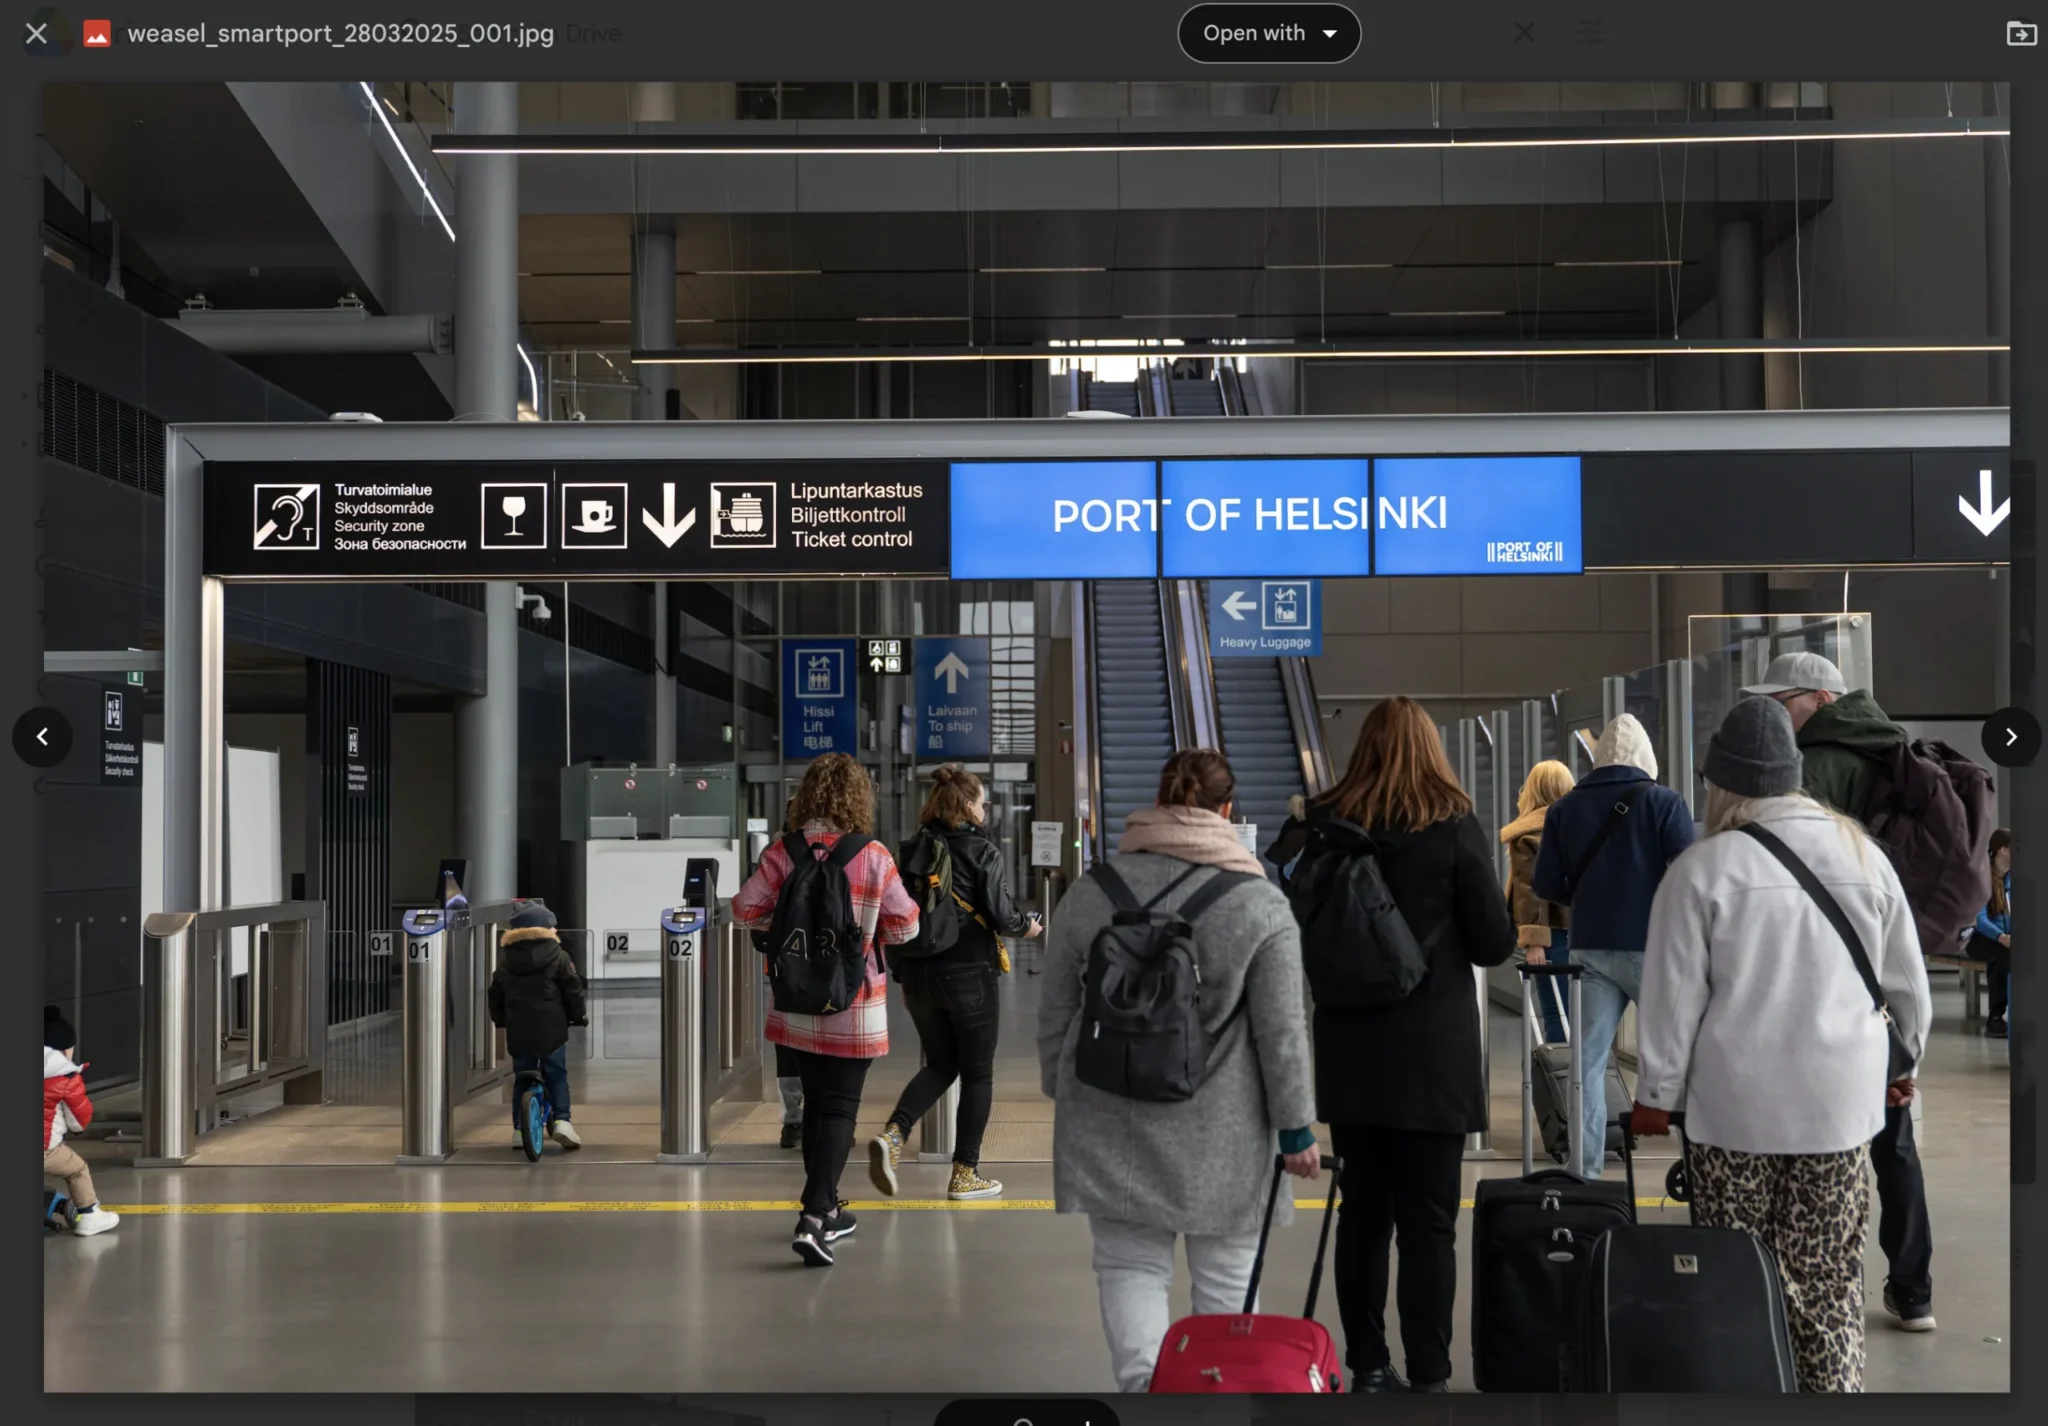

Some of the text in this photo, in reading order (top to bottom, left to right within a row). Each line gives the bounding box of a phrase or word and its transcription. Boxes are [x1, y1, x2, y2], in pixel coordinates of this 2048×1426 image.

[335, 484, 433, 496] Turvatoimialue
[792, 482, 923, 502] Lipuntarkastus
[335, 501, 434, 517] Skyddsområde
[1054, 496, 1447, 533] PORT OF HELSINKI
[792, 506, 906, 527] Biljettkontroll
[335, 520, 425, 534] Security zone
[335, 538, 467, 550] Зона безопасности
[792, 530, 913, 548] Ticket control
[1497, 541, 1553, 552] PORT OF
[1497, 551, 1553, 562] HELSINKI
[1220, 636, 1311, 650] Heavy Luggage
[803, 705, 835, 717] Hissi
[928, 705, 977, 717] Laivaan
[803, 720, 824, 733] Lift
[928, 720, 973, 734] To ship
[371, 935, 390, 951] 01
[607, 935, 628, 951] 02
[670, 940, 692, 956] 02
[409, 942, 429, 959] 01
